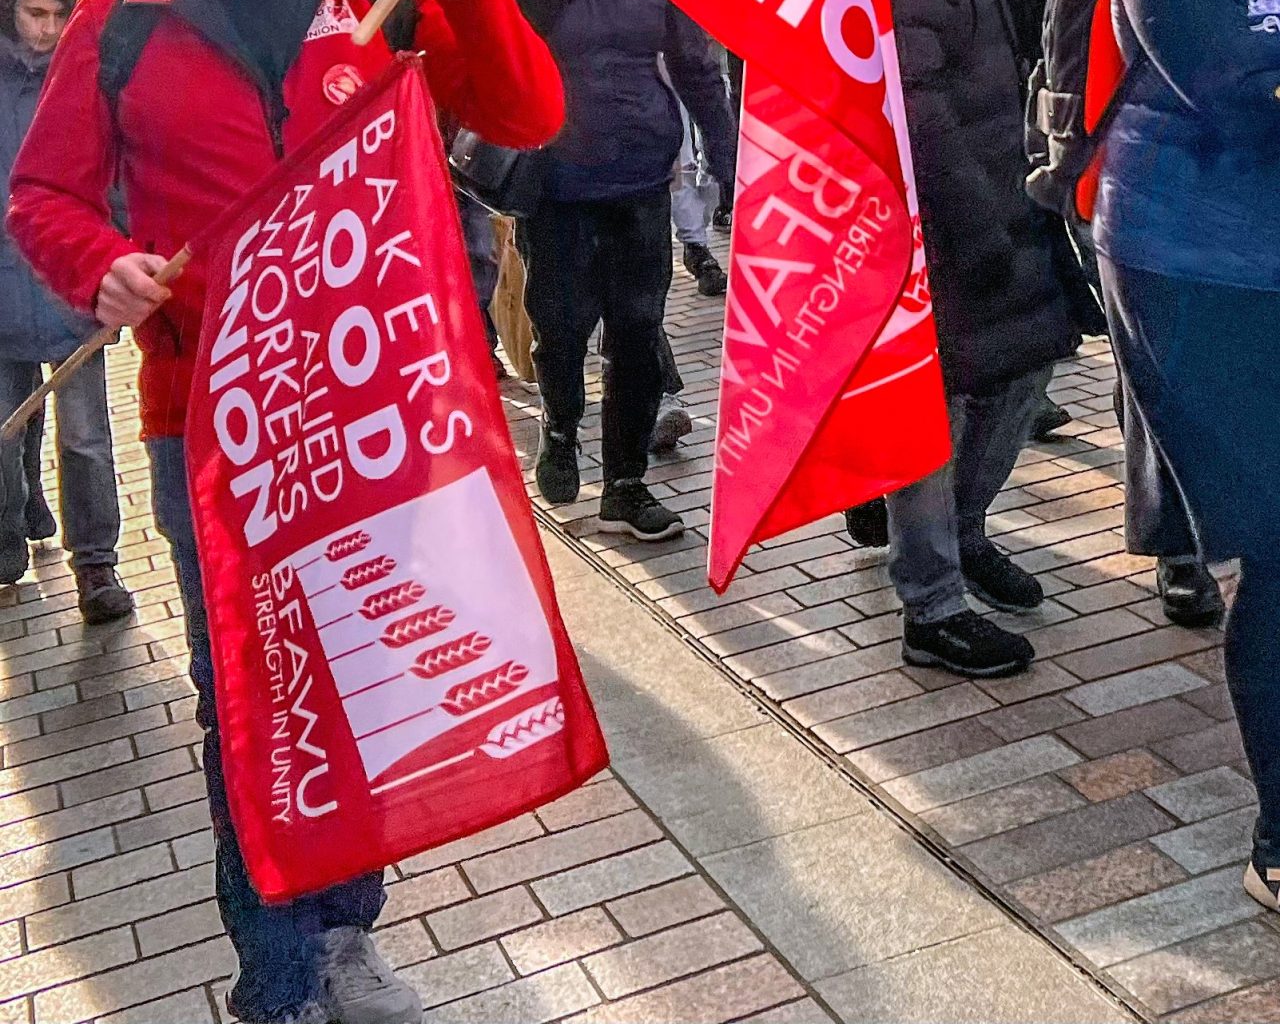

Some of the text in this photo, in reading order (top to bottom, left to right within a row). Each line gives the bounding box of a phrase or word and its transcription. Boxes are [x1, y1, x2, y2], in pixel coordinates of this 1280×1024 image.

[209, 219, 278, 549] UNION
[251, 191, 309, 524] WORKERS
[287, 184, 343, 503] AND ALLIED
[319, 138, 408, 481] FOOD
[362, 109, 474, 456] BAKERS
[252, 573, 292, 824] STRENGTH IN UNITY
[270, 560, 338, 818] BFAWU
